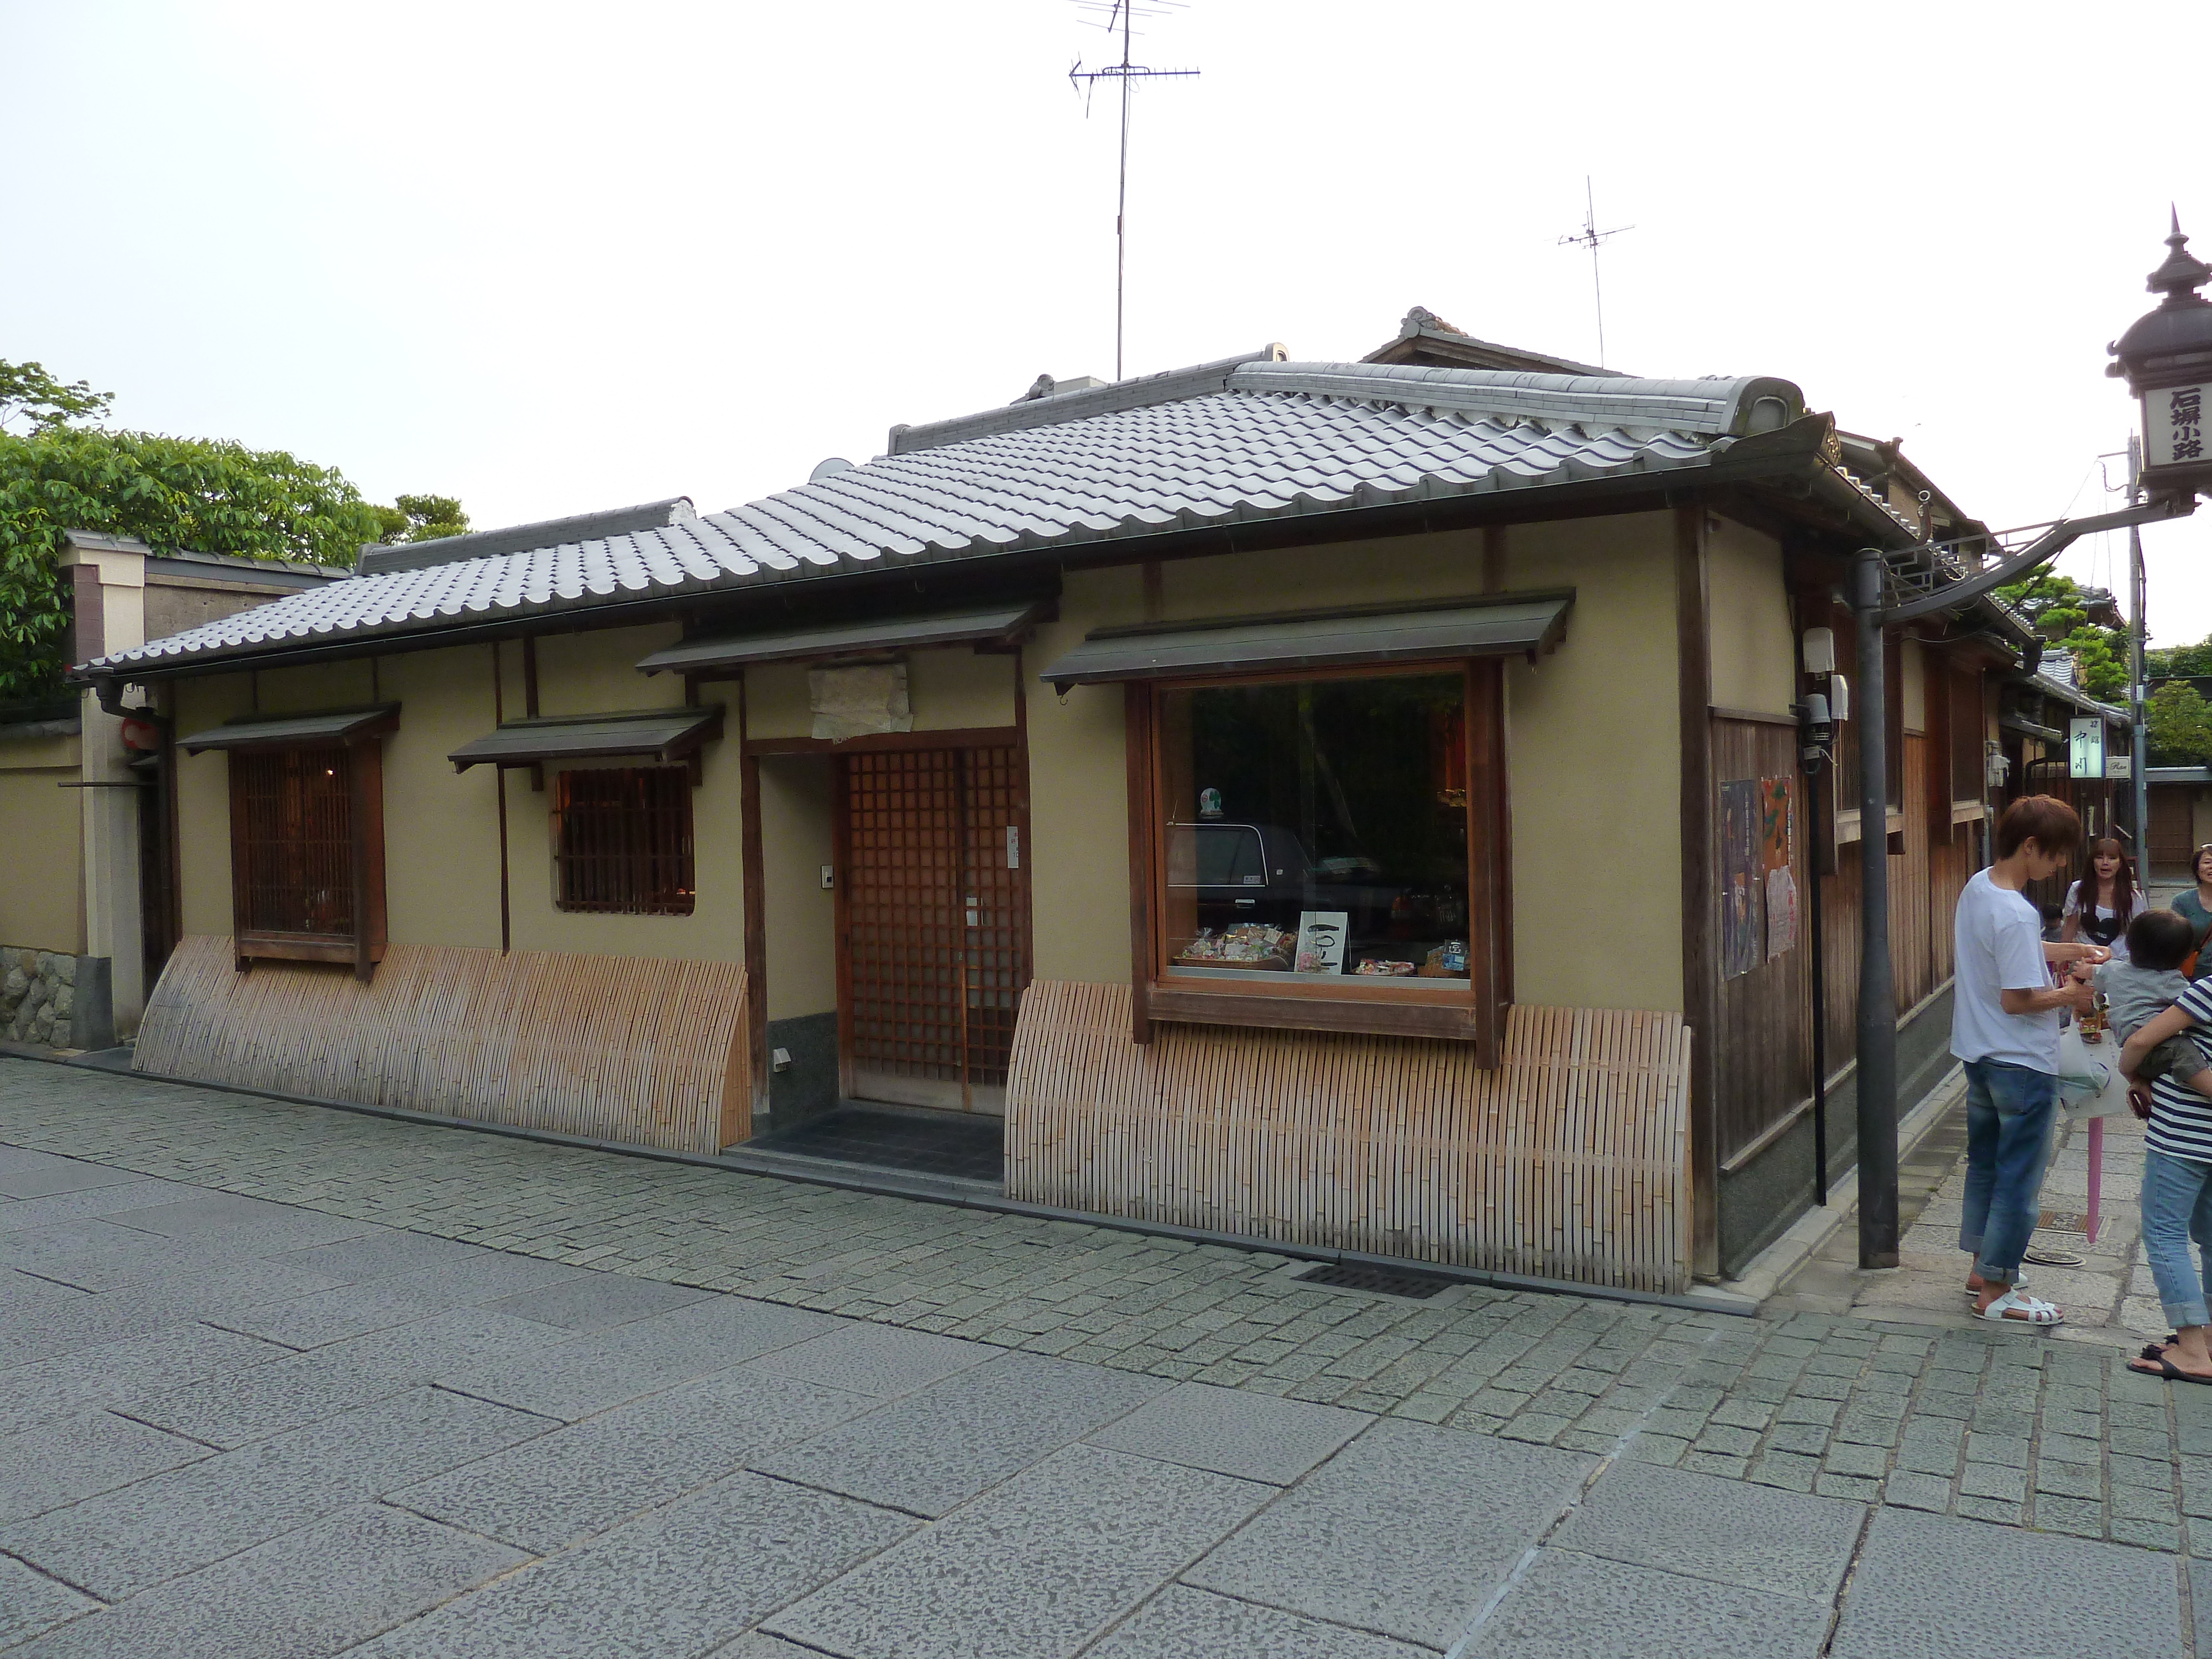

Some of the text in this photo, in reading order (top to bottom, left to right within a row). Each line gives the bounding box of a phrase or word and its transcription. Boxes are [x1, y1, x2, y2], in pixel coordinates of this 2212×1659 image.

[2169, 388, 2204, 461] 石塀小路
[2074, 731, 2087, 775] 中川
